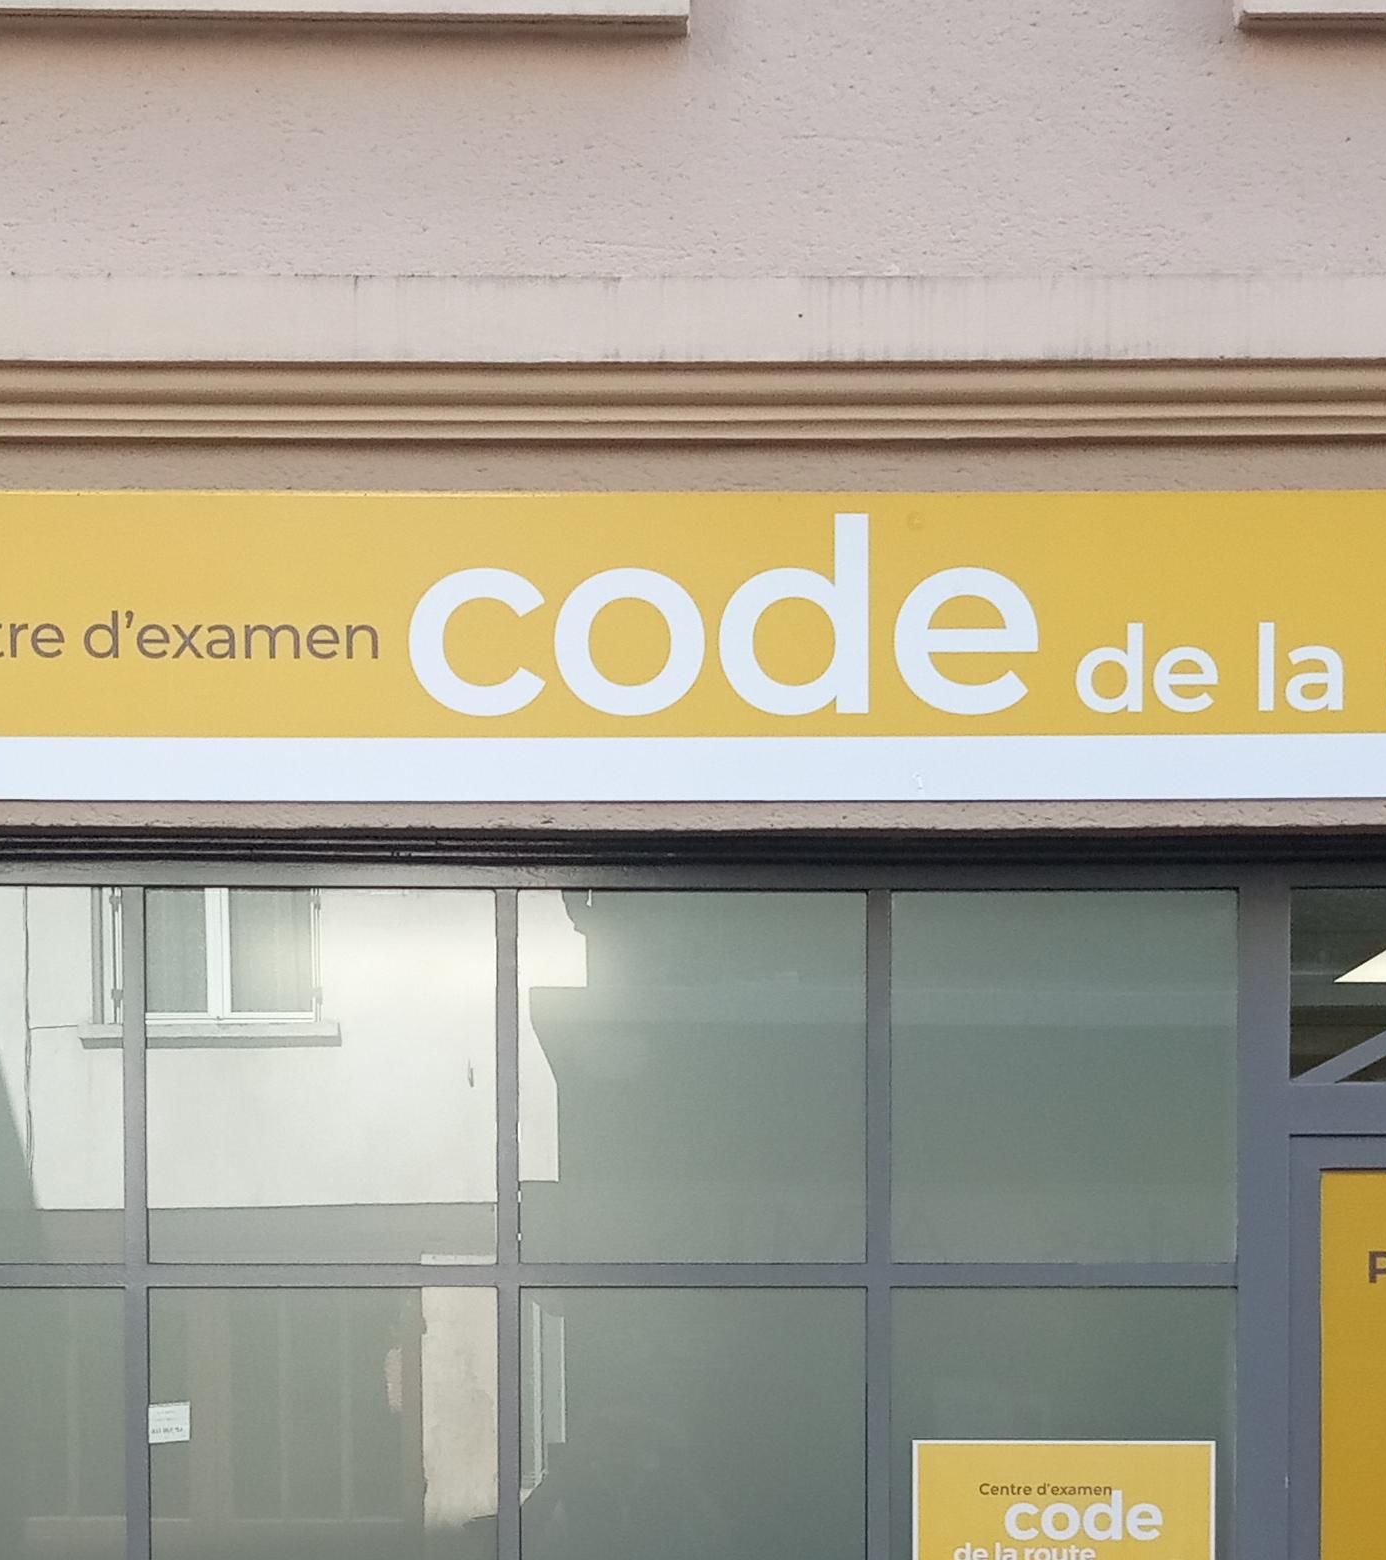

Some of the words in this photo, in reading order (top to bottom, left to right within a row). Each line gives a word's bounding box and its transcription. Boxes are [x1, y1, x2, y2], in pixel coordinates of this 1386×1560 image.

[84, 610, 378, 659] d’examen
[409, 513, 1039, 716] code
[1076, 623, 1218, 713] de
[1258, 621, 1344, 711] la
[979, 1483, 1032, 1495] Centre
[1037, 1483, 1112, 1495] d'examen
[1004, 1490, 1163, 1541] code
